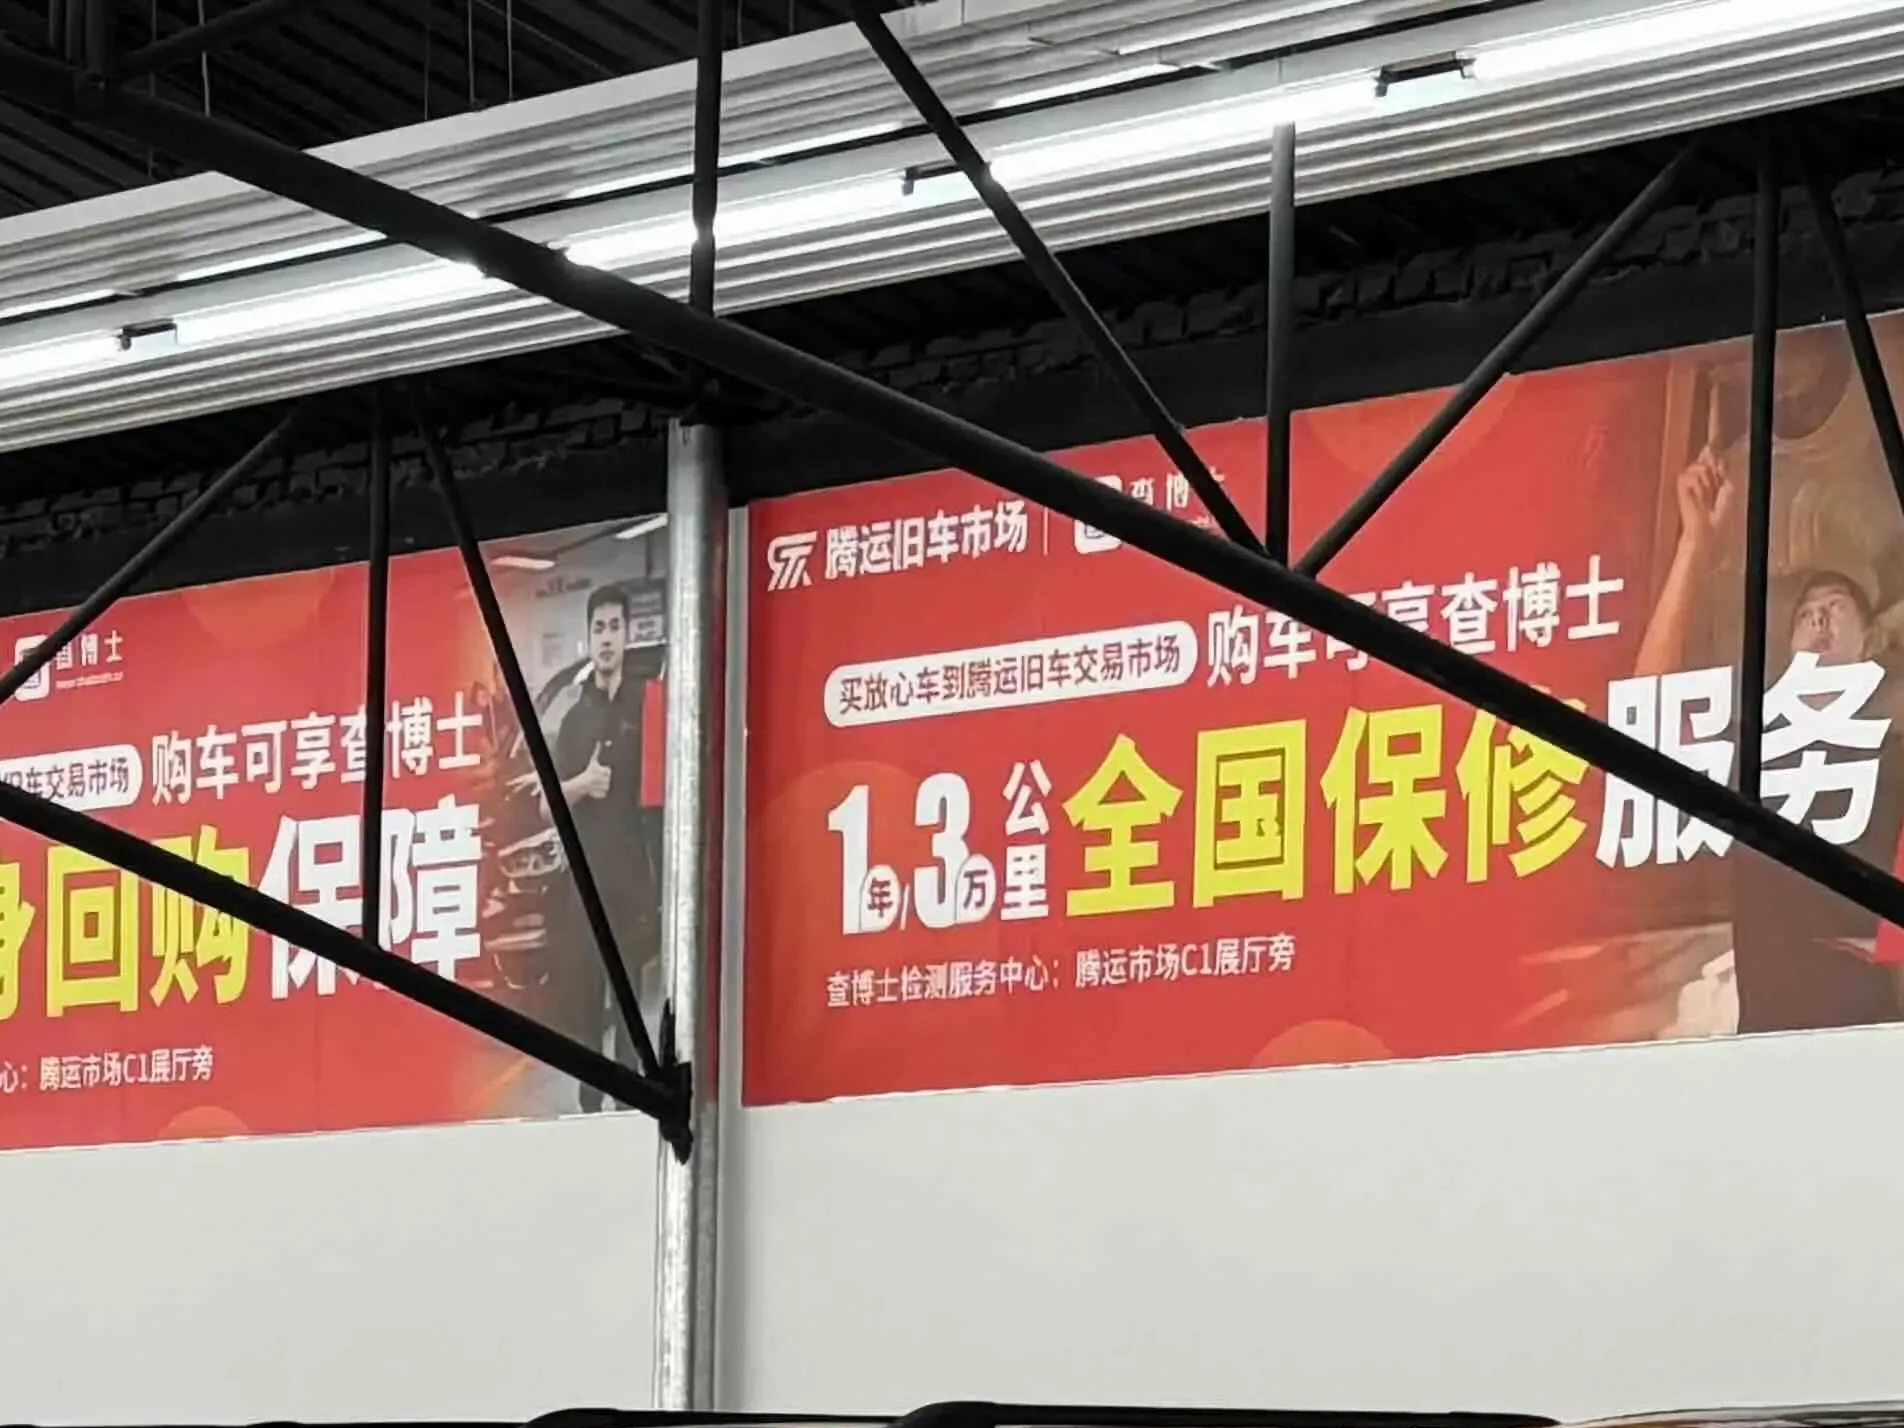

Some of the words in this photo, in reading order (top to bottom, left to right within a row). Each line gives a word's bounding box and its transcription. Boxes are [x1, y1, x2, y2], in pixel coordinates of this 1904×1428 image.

[824, 500, 1028, 581] 腾运旧车市场
[838, 633, 1181, 714] 买放心车到腾运旧车交易市场
